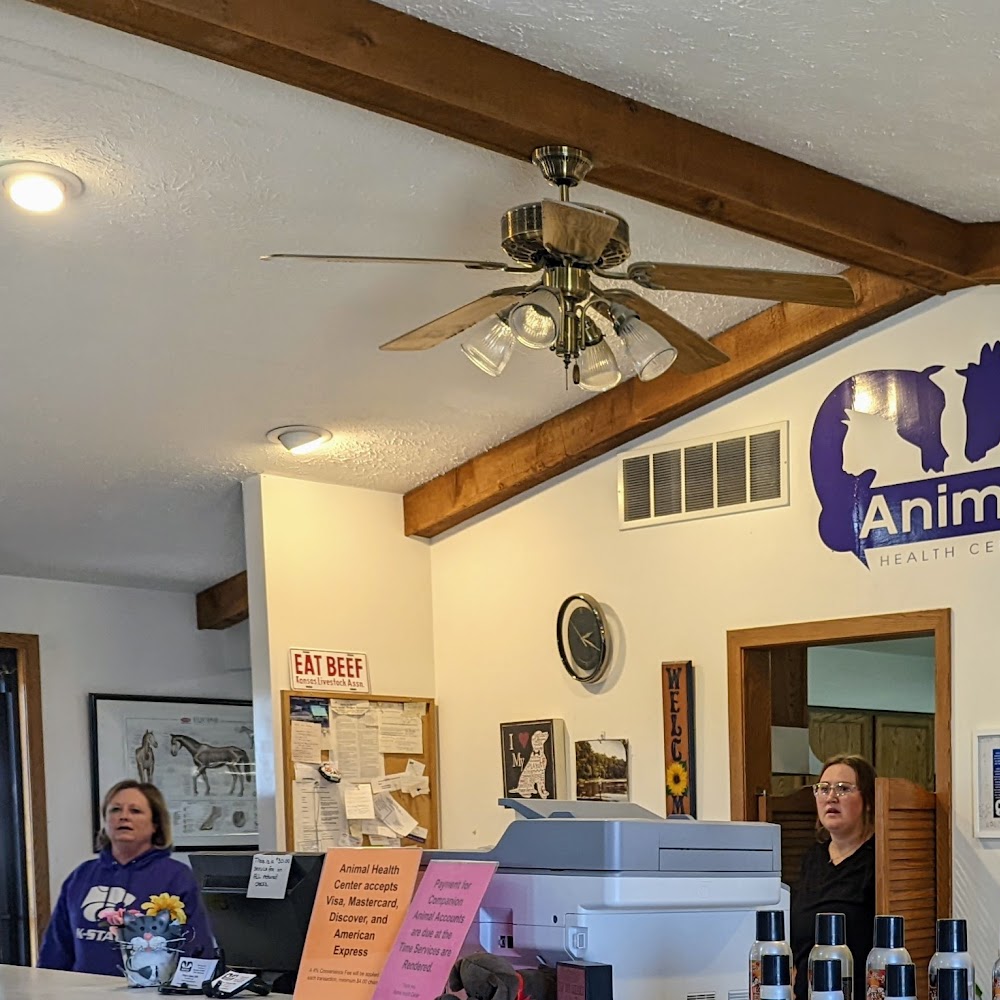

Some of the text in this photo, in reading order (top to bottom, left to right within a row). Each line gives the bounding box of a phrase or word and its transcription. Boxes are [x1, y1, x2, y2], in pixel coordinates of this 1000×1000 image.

[880, 546, 955, 567] HEALTH
[295, 654, 363, 678] EAT BEEF
[296, 676, 317, 685] Kansas
[317, 677, 347, 686] Livestock
[508, 733, 514, 750] I
[512, 753, 525, 770] My
[340, 864, 400, 875] Animal Health
[334, 880, 398, 893] Center accepts
[434, 879, 472, 891] Payment for
[326, 896, 399, 910] Visa, Mastercard,
[428, 895, 463, 906] Companion
[329, 912, 388, 925] Discover, and
[413, 910, 465, 923] Animal Accounts
[76, 927, 119, 942] K-STA
[334, 929, 375, 940] American
[411, 928, 452, 939] are due at the
[333, 945, 368, 957] Express
[399, 942, 452, 957] Time Services are
[402, 960, 433, 972] Rendered.
